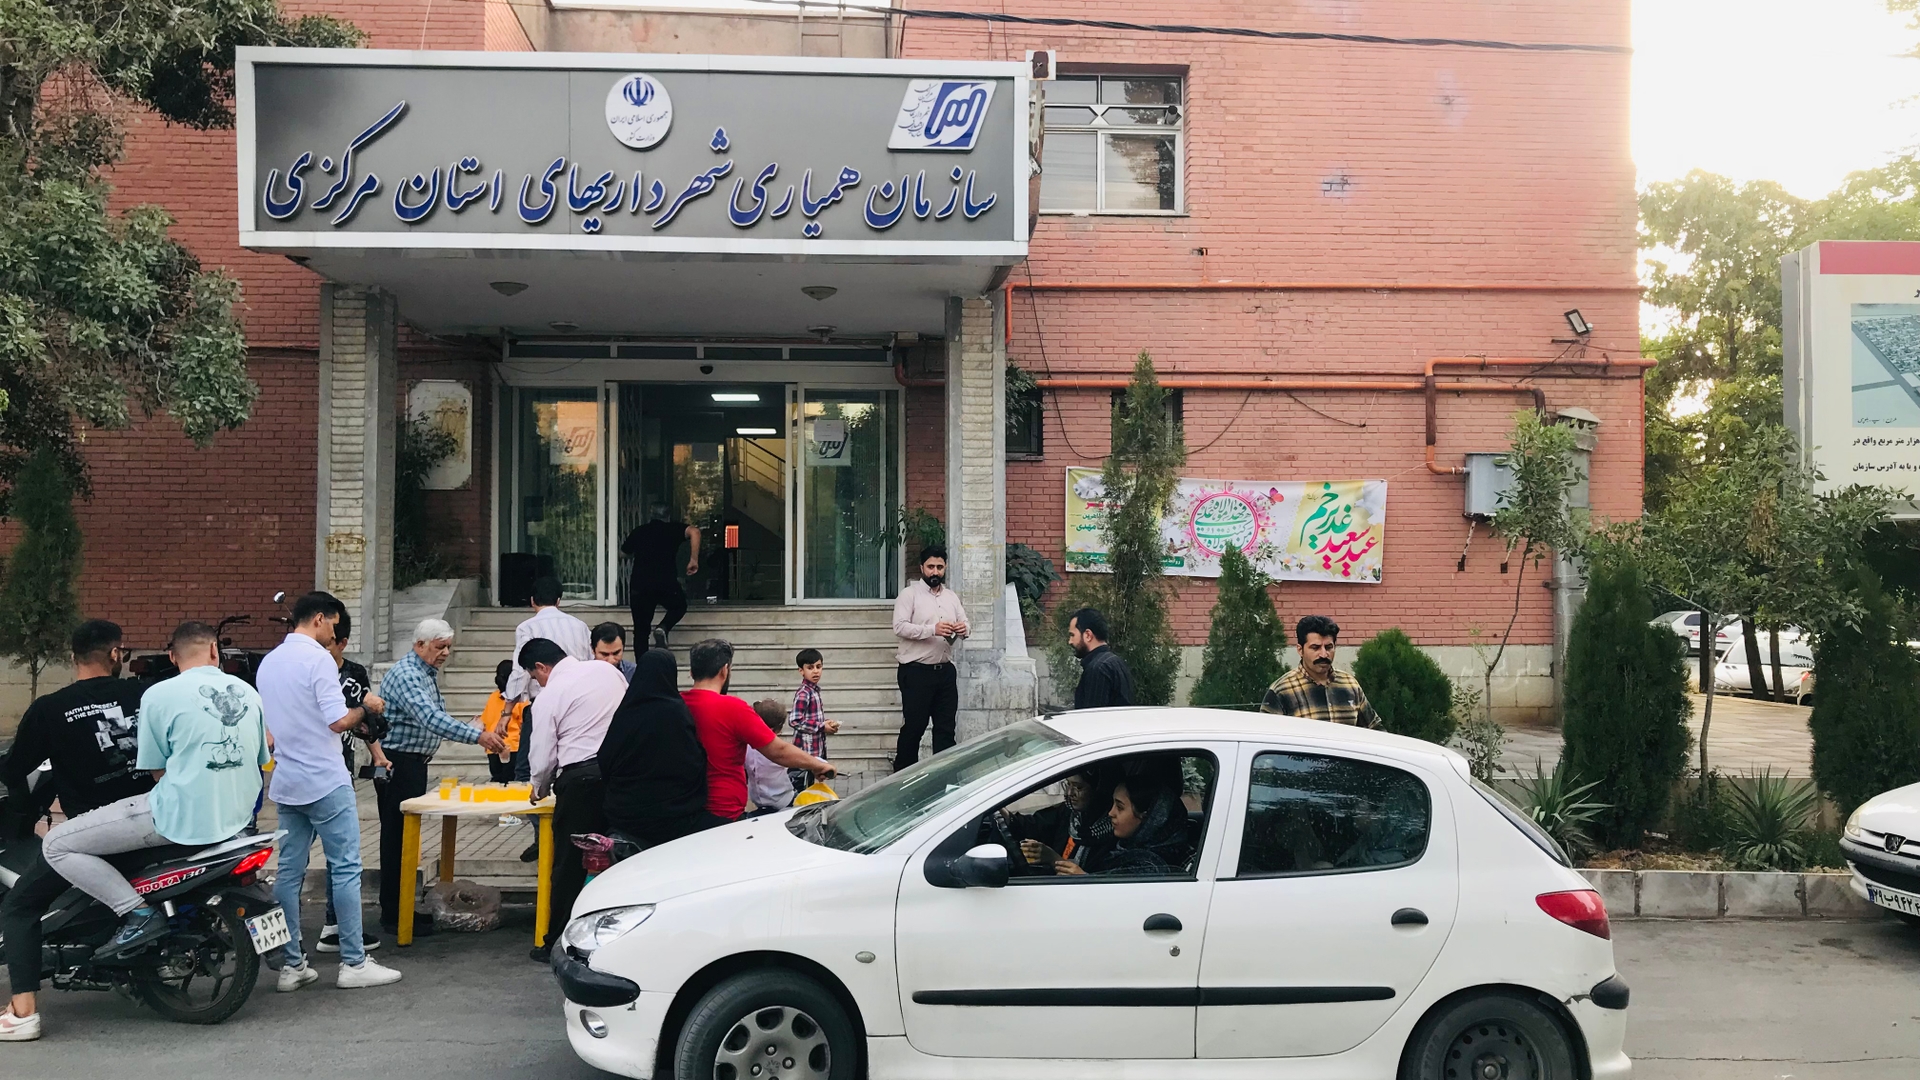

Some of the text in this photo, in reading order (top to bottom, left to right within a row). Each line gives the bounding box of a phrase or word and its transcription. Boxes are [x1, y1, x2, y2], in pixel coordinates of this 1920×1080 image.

[610, 110, 668, 125] جمهوری اسلامی ایران
[263, 100, 998, 238] سازمان همیاری شهرداریهای استان مرکزی
[1852, 438, 1861, 447] در
[1862, 435, 1877, 447] واقع
[1878, 438, 1893, 447] مربع
[1852, 462, 1875, 472] سازمان
[1876, 461, 1897, 472] آدرس
[1299, 482, 1339, 549] خم
[1314, 526, 1379, 577] عید سعید
[64, 707, 82, 717] FAITH
[90, 701, 118, 710] ONESELF
[74, 712, 87, 721] THE
[88, 709, 104, 717] BEST
[134, 875, 180, 895] HOOKA
